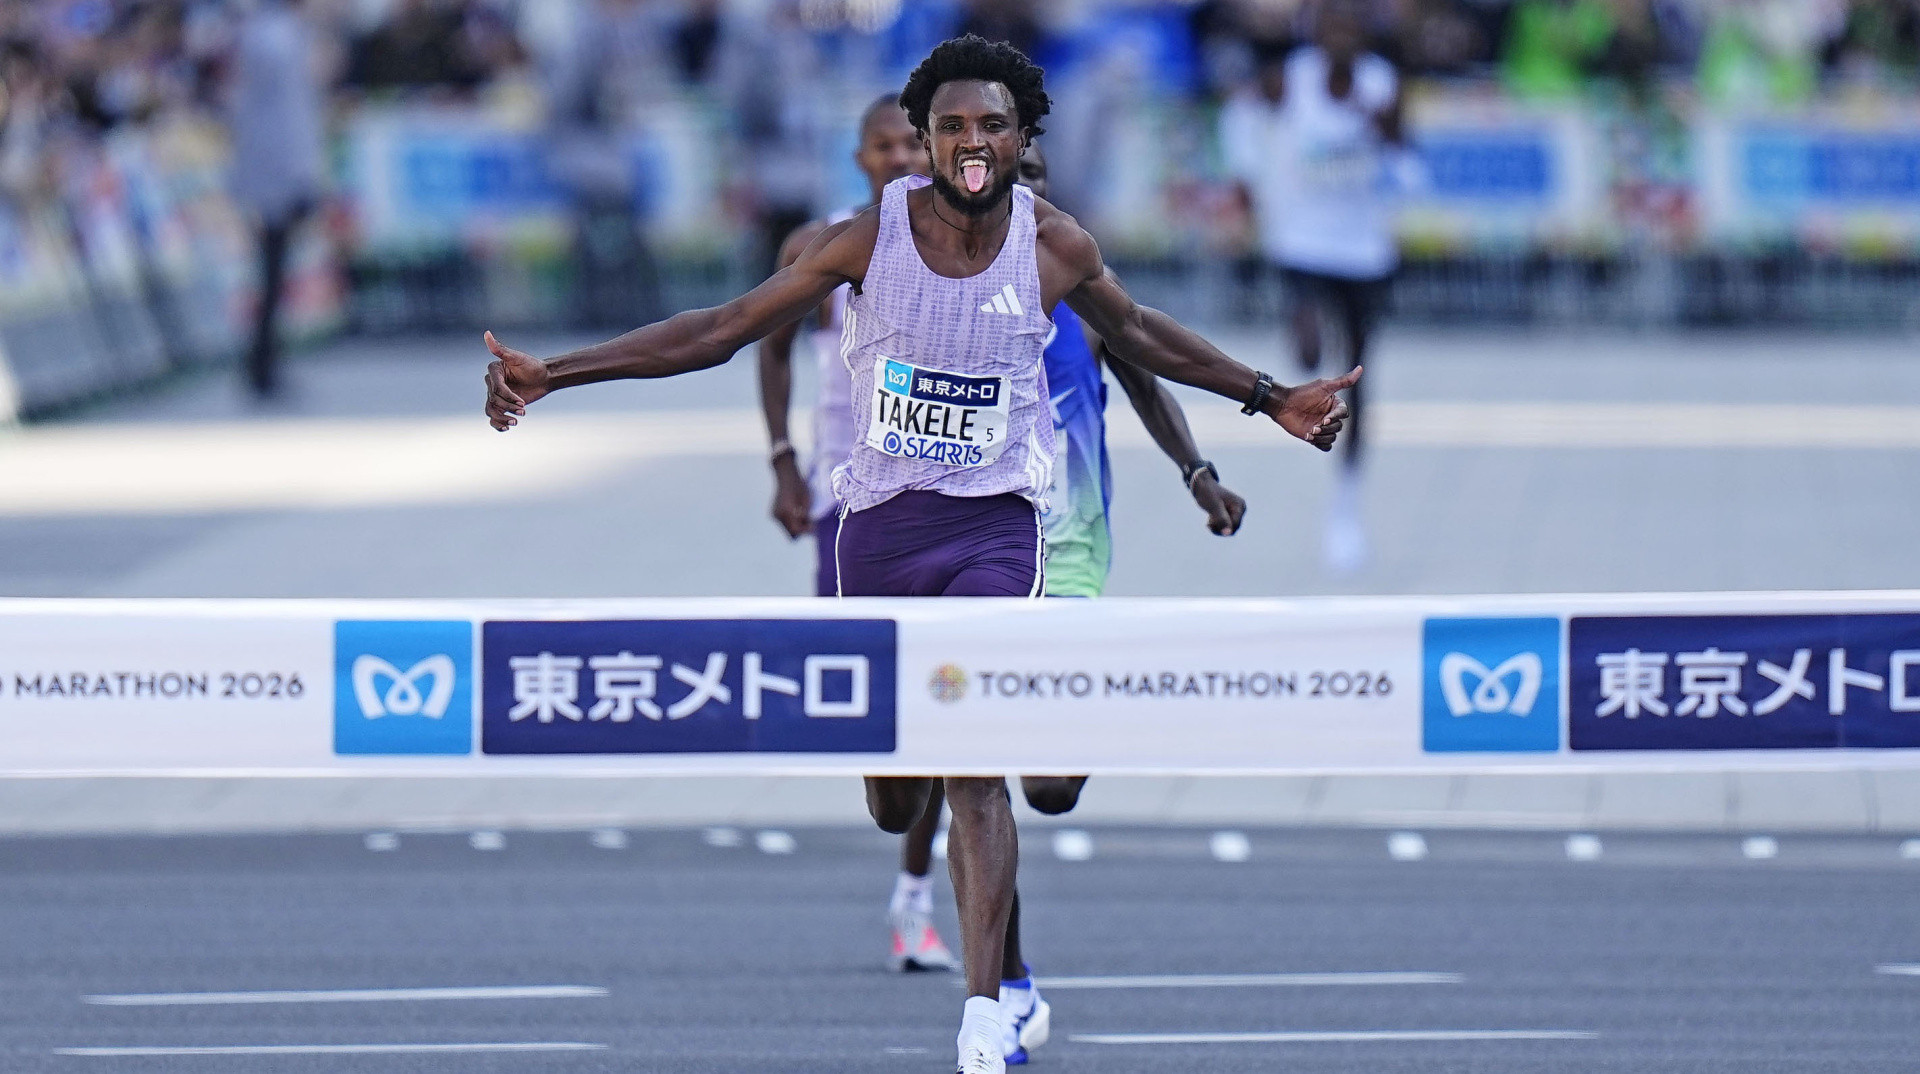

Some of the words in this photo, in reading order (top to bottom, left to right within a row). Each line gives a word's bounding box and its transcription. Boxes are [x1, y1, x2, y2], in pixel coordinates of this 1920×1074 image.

[916, 377, 995, 399] 東京メトロ
[877, 389, 978, 442] TAKELE
[986, 427, 994, 442] 5
[15, 672, 208, 697] MARATHON
[221, 672, 304, 698] 2026
[509, 652, 869, 723] 東京メトロ
[979, 671, 1092, 697] TOKYO
[1104, 671, 1297, 697] MARATHON
[1309, 671, 1393, 697] 2026
